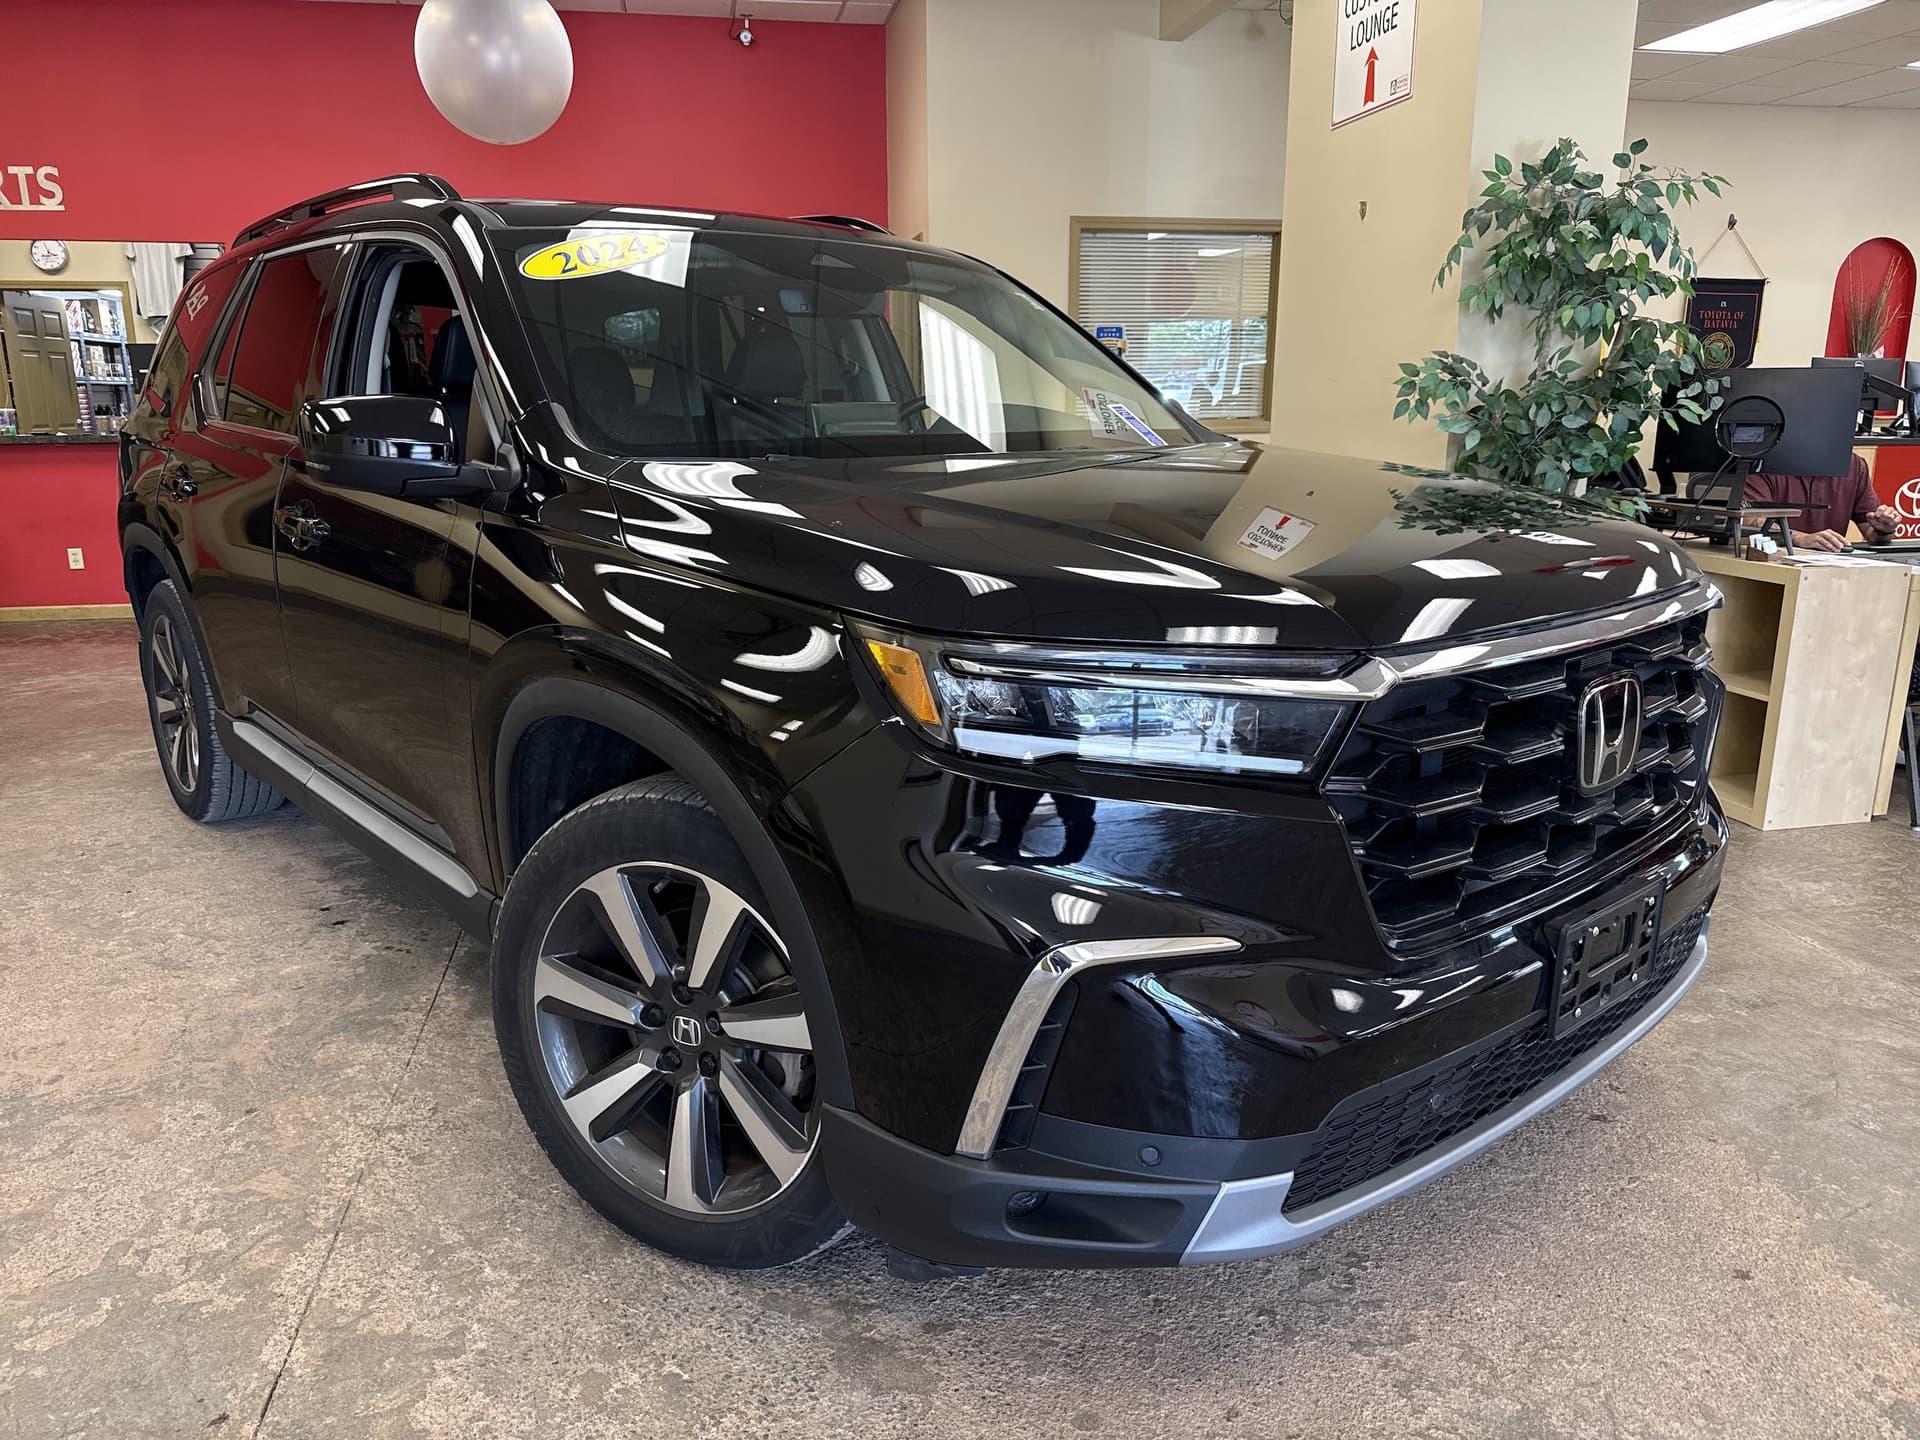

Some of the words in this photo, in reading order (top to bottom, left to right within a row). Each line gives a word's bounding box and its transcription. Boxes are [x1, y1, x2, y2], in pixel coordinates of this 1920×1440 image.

[1350, 1, 1399, 51] LOUNGE
[552, 235, 648, 274] 2024
[1699, 311, 1731, 319] TOYOTA
[1733, 312, 1745, 320] OF
[1704, 320, 1737, 328] BATAVIA
